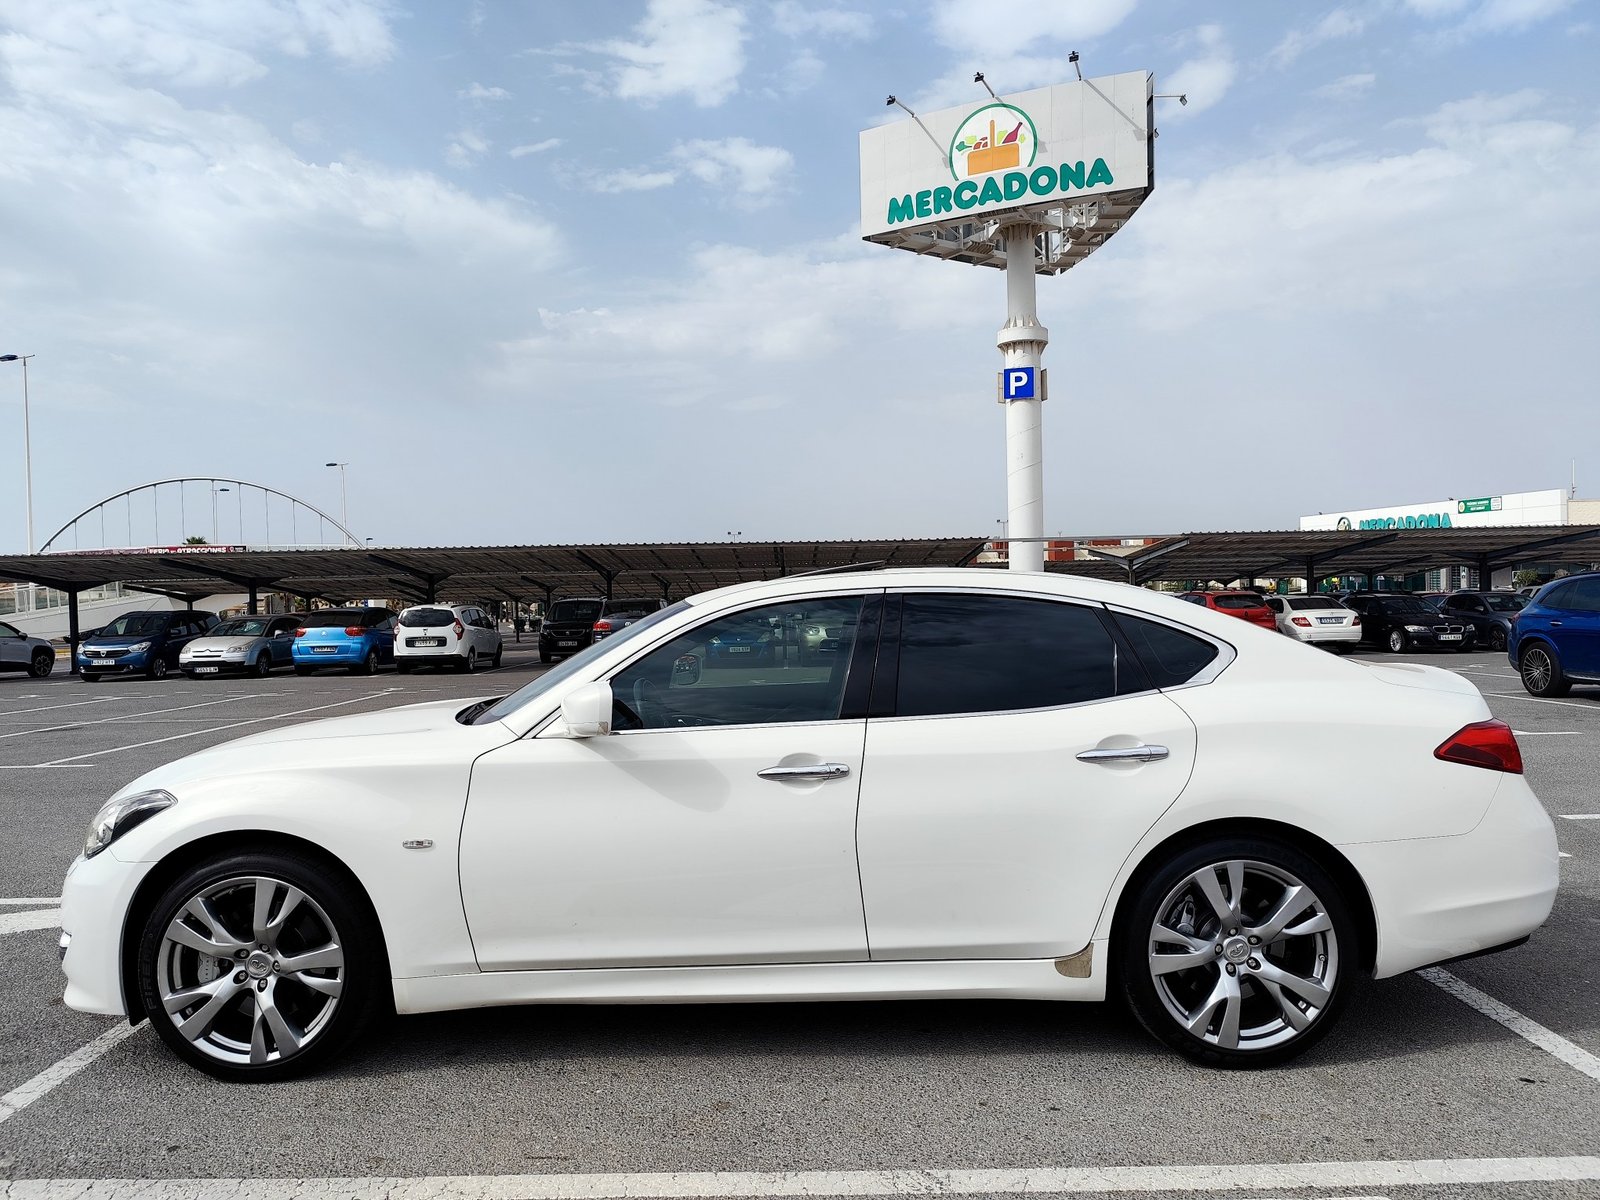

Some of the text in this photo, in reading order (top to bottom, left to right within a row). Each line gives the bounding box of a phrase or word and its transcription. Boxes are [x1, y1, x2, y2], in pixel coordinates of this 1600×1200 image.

[887, 157, 1114, 225] MERCADONA
[1009, 371, 1029, 396] P
[1359, 512, 1453, 530] MERCADONA
